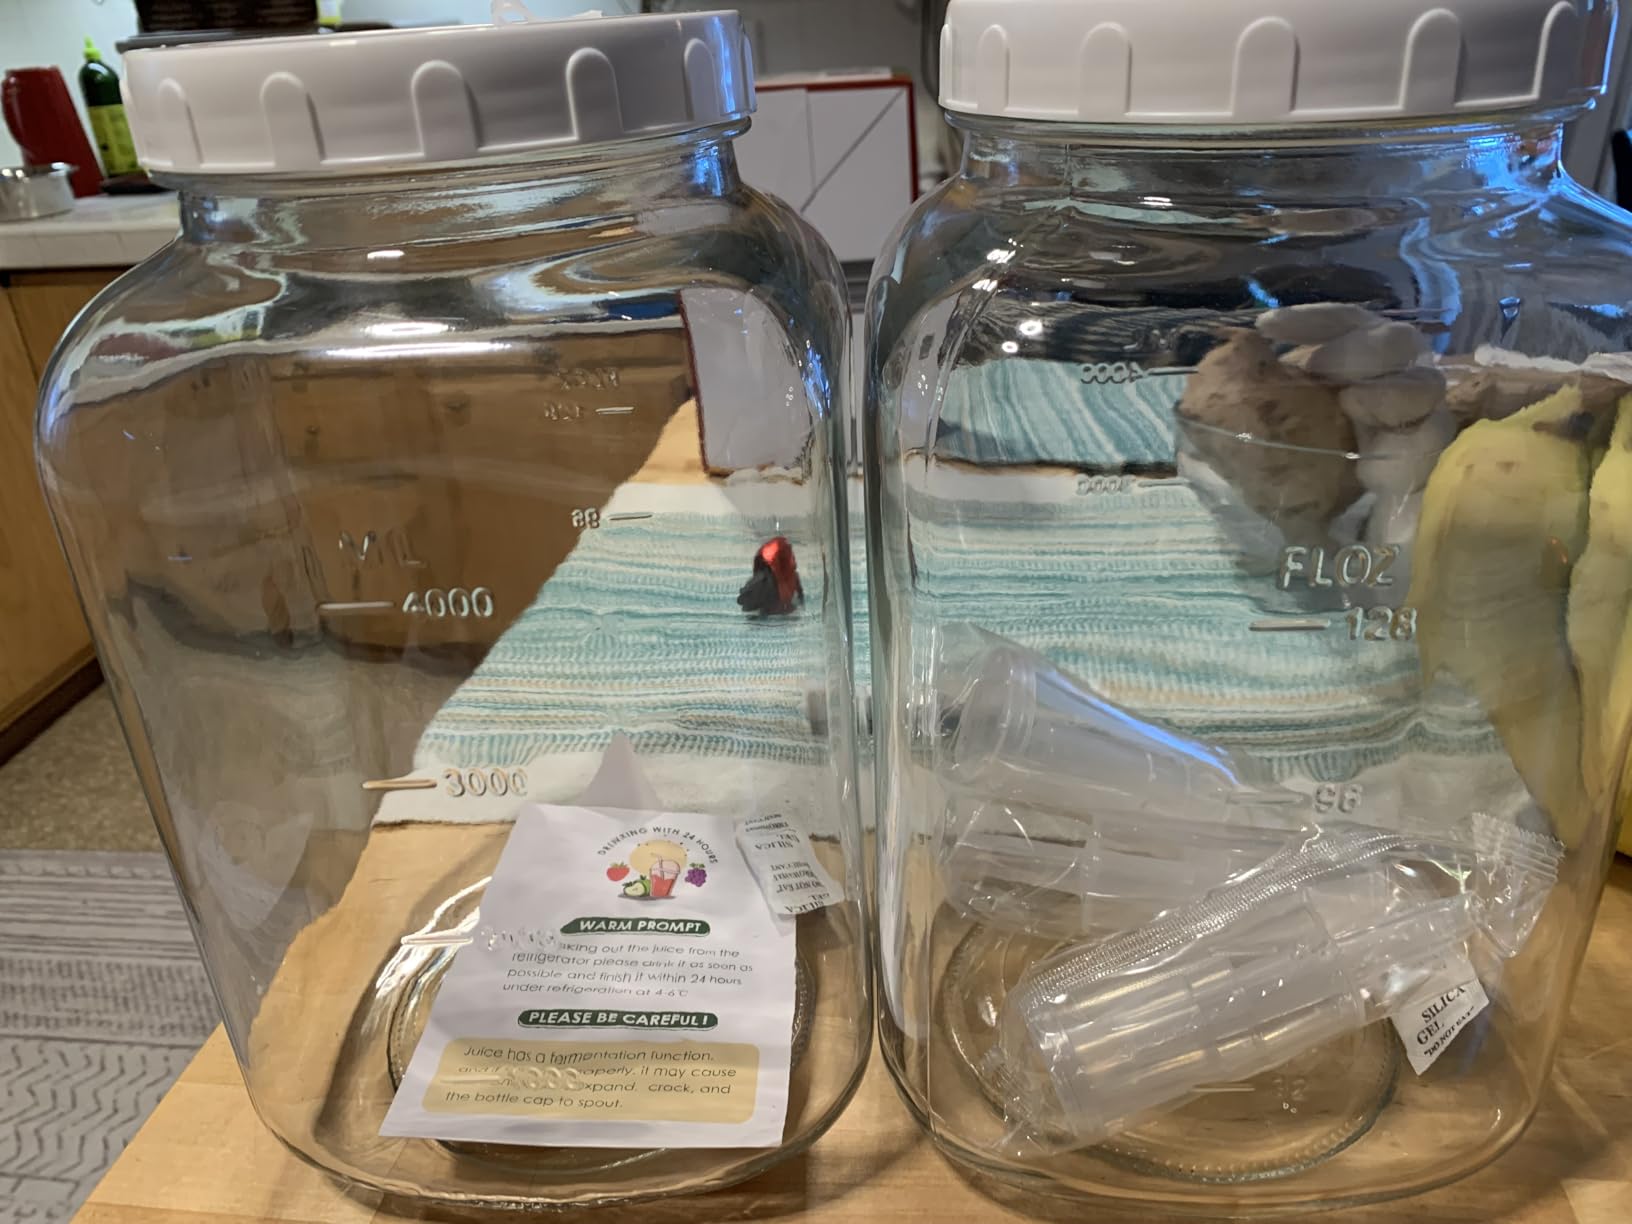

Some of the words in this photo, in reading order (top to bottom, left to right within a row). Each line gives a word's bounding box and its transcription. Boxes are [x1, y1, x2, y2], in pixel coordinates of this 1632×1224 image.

[402, 586, 495, 618] 4000
[1347, 605, 1418, 641] 128
[443, 767, 529, 798] 3000
[1314, 784, 1362, 814] 96
[652, 826, 681, 836] WITH
[682, 831, 697, 842] 24
[696, 839, 718, 864] HOURS
[580, 920, 632, 932] WARM
[637, 920, 702, 933] PROMPT
[559, 942, 598, 954] aking
[601, 945, 624, 953] out
[627, 944, 649, 953] the
[652, 944, 684, 955] juice
[689, 947, 716, 956] from
[720, 949, 740, 958] the
[512, 952, 589, 965] refrigerator
[593, 957, 638, 967] please
[642, 960, 674, 968] drink
[690, 961, 704, 969] as
[708, 961, 736, 971] soon
[740, 963, 753, 972] as
[507, 968, 562, 979] possible
[567, 971, 597, 980] and
[600, 971, 631, 983] finish
[635, 971, 643, 981] it
[648, 972, 686, 983] within
[690, 973, 706, 984] 24
[710, 974, 743, 985] hours
[503, 983, 545, 993] under
[547, 984, 632, 995] refrigeration
[636, 989, 650, 997] at
[1421, 986, 1466, 1023] SILICA
[528, 1011, 592, 1024] PLEASE
[596, 1012, 617, 1024] BE
[463, 1045, 503, 1058] Juice
[507, 1047, 531, 1062] has
[535, 1051, 546, 1064] a
[550, 1050, 647, 1065] fermentation
[641, 1065, 649, 1076] it
[653, 1067, 686, 1079] may
[691, 1068, 737, 1077] cause
[700, 1084, 731, 1094] and
[445, 1091, 471, 1101] the
[474, 1092, 519, 1103] bottle
[523, 1096, 554, 1107] cap
[559, 1097, 574, 1106] to
